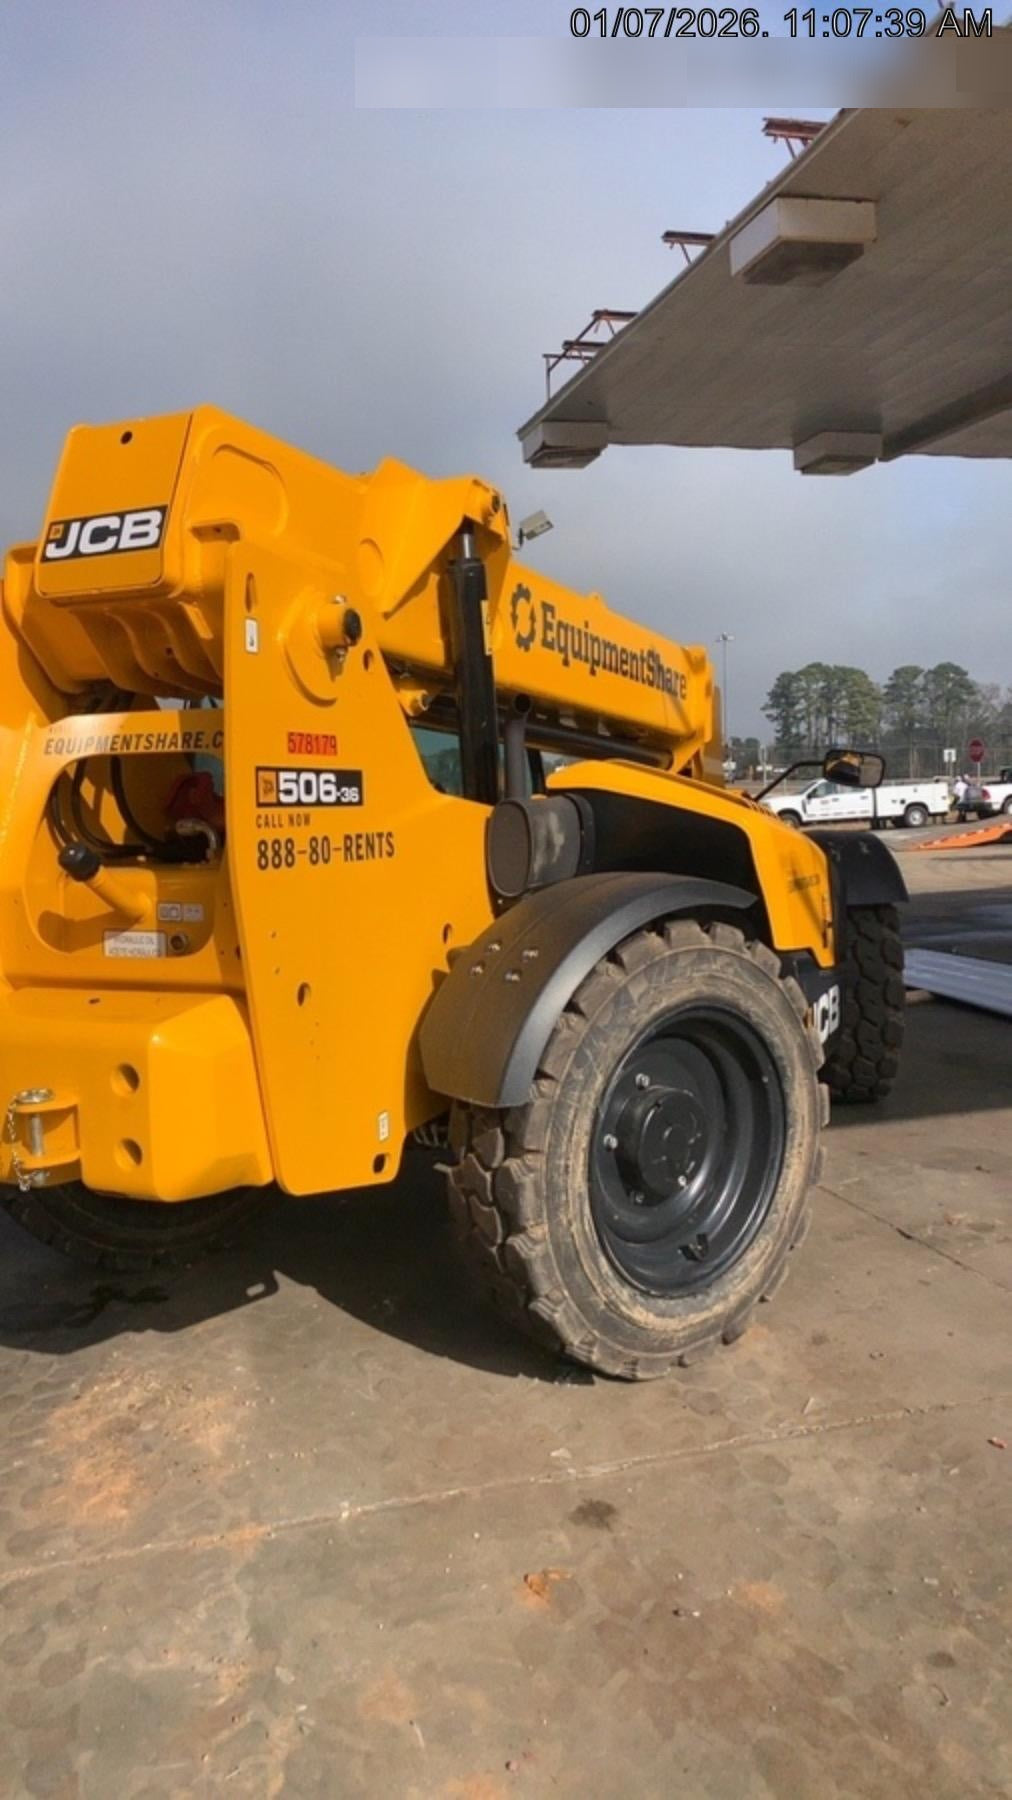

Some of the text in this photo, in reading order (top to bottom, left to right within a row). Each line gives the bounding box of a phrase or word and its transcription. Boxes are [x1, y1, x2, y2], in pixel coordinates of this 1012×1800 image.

[45, 509, 163, 559] JCB
[541, 600, 687, 700] EquipmentShare
[287, 731, 338, 756] 578179
[256, 813, 311, 829] CALL NOW
[257, 831, 395, 871] 888-80-RENTS
